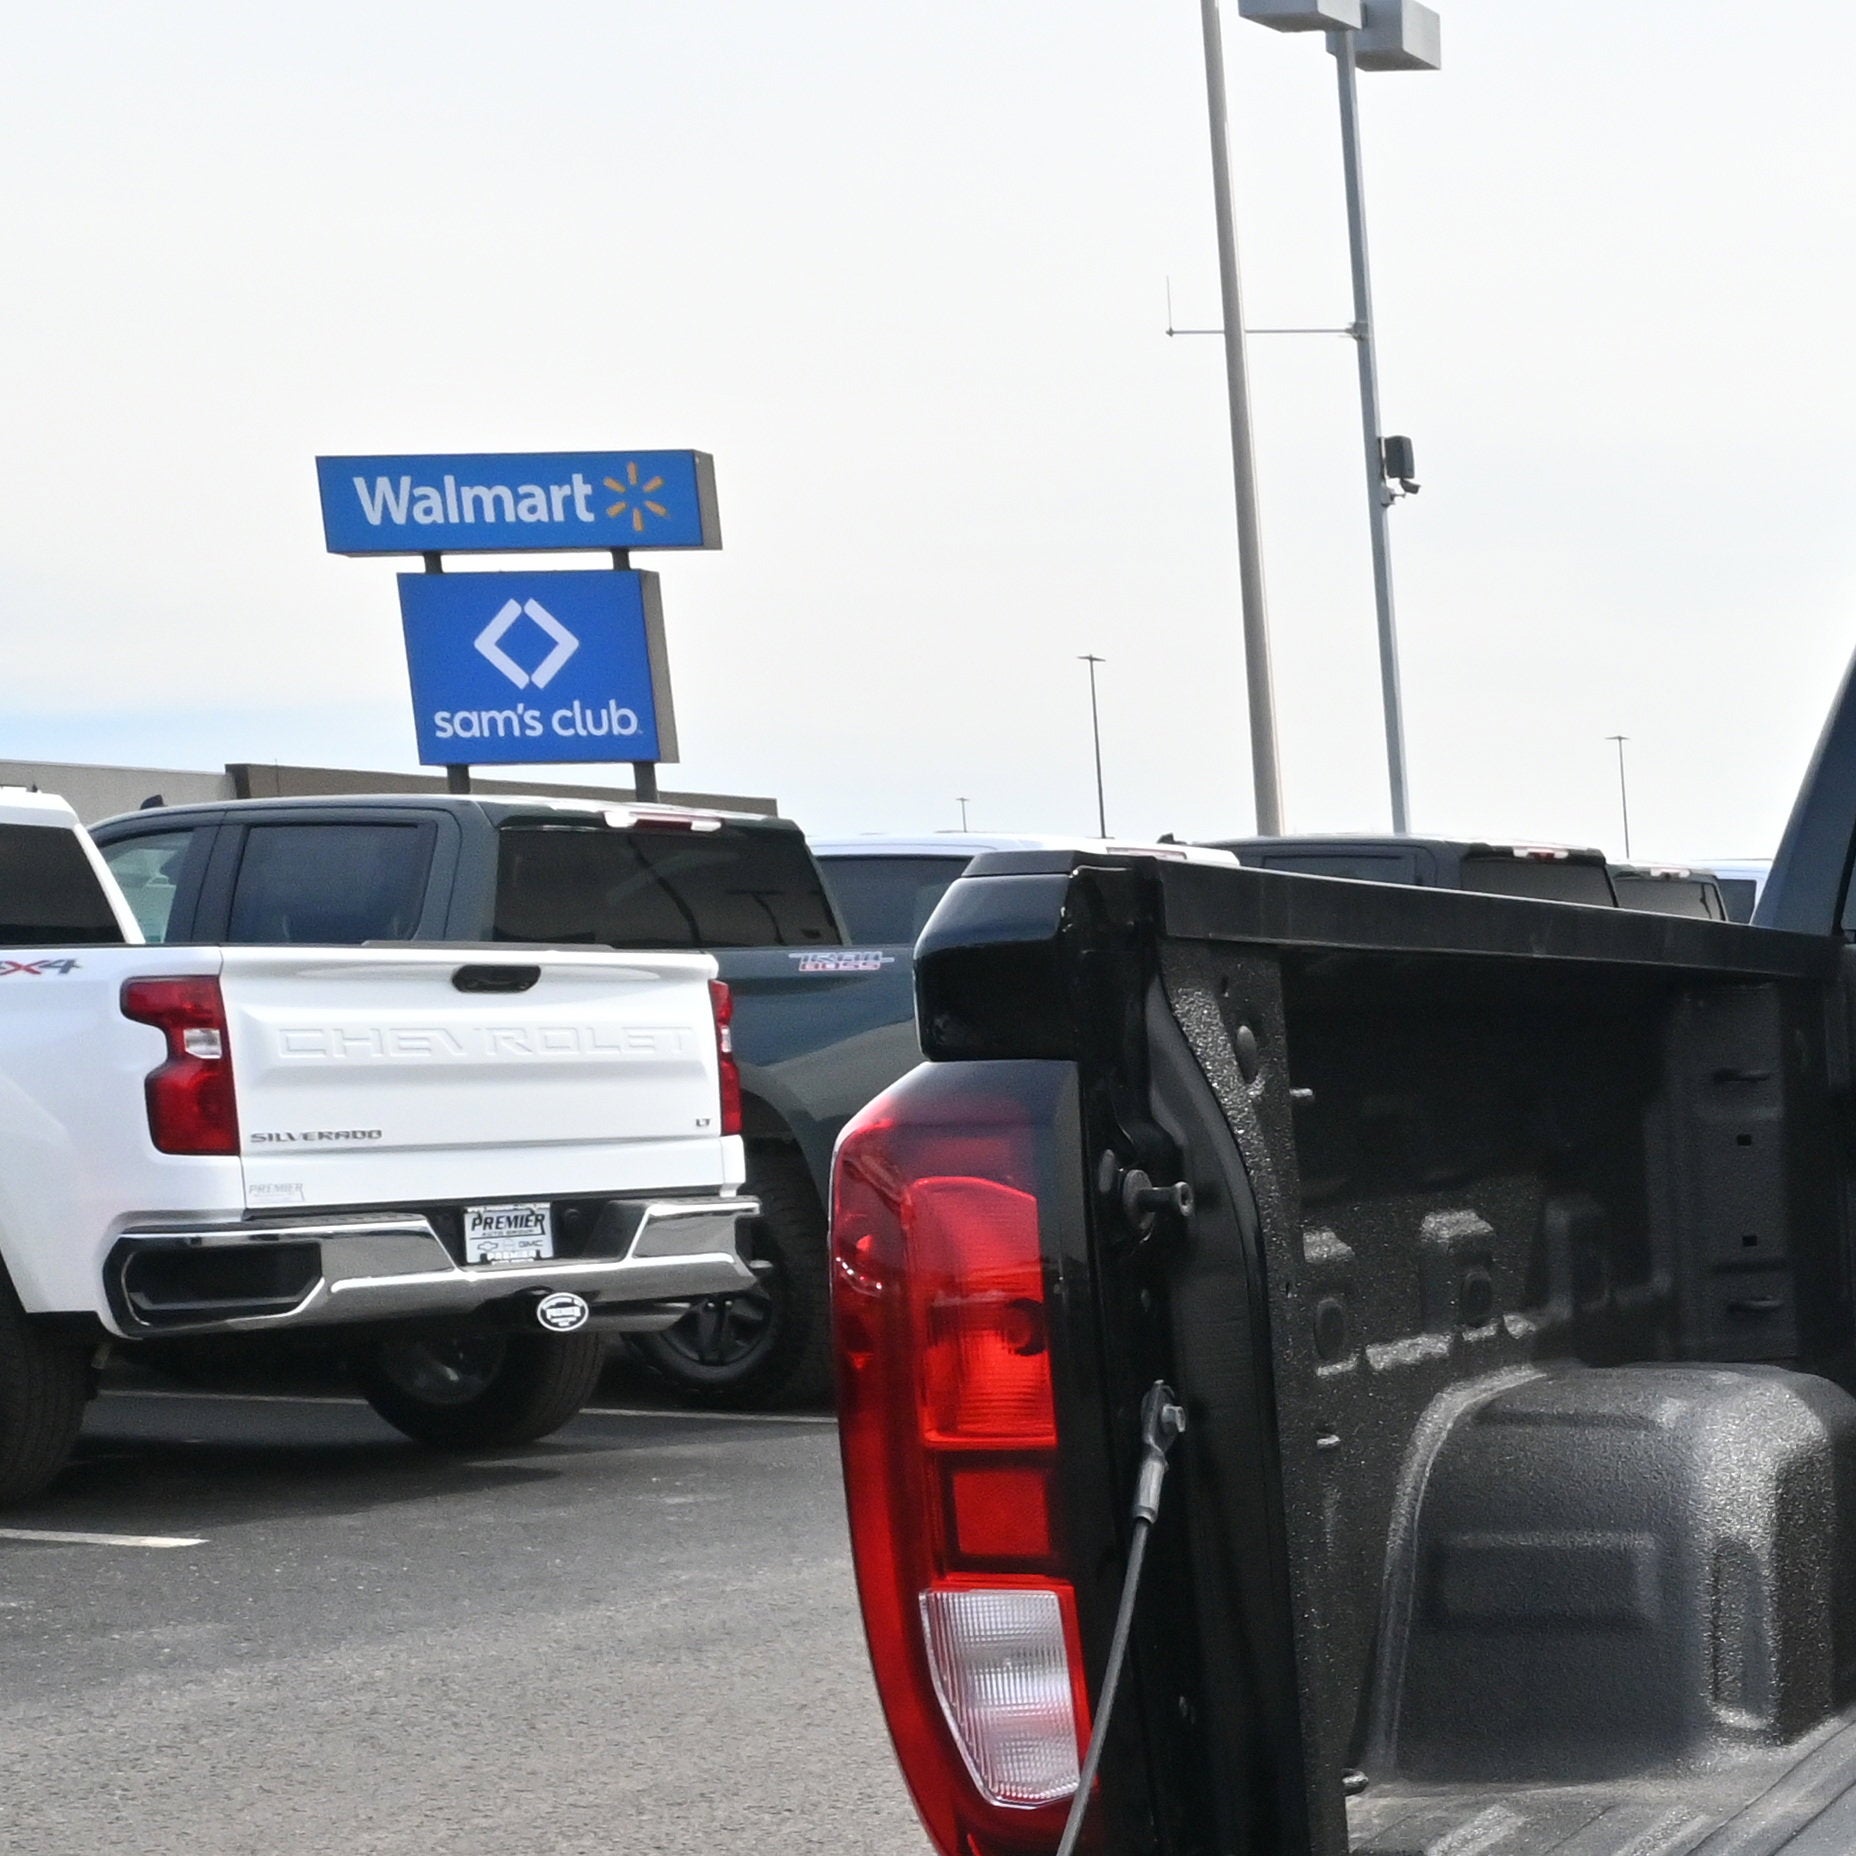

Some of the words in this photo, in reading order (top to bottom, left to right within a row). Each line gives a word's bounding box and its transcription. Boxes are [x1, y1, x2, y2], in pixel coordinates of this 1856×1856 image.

[353, 473, 595, 526] Walmart
[434, 703, 543, 738] sam's
[551, 699, 639, 736] club
[277, 1026, 695, 1059] CHEVROLET
[696, 1118, 711, 1128] LT
[250, 1129, 382, 1144] SILVERADO
[471, 1213, 546, 1232] PREMIER
